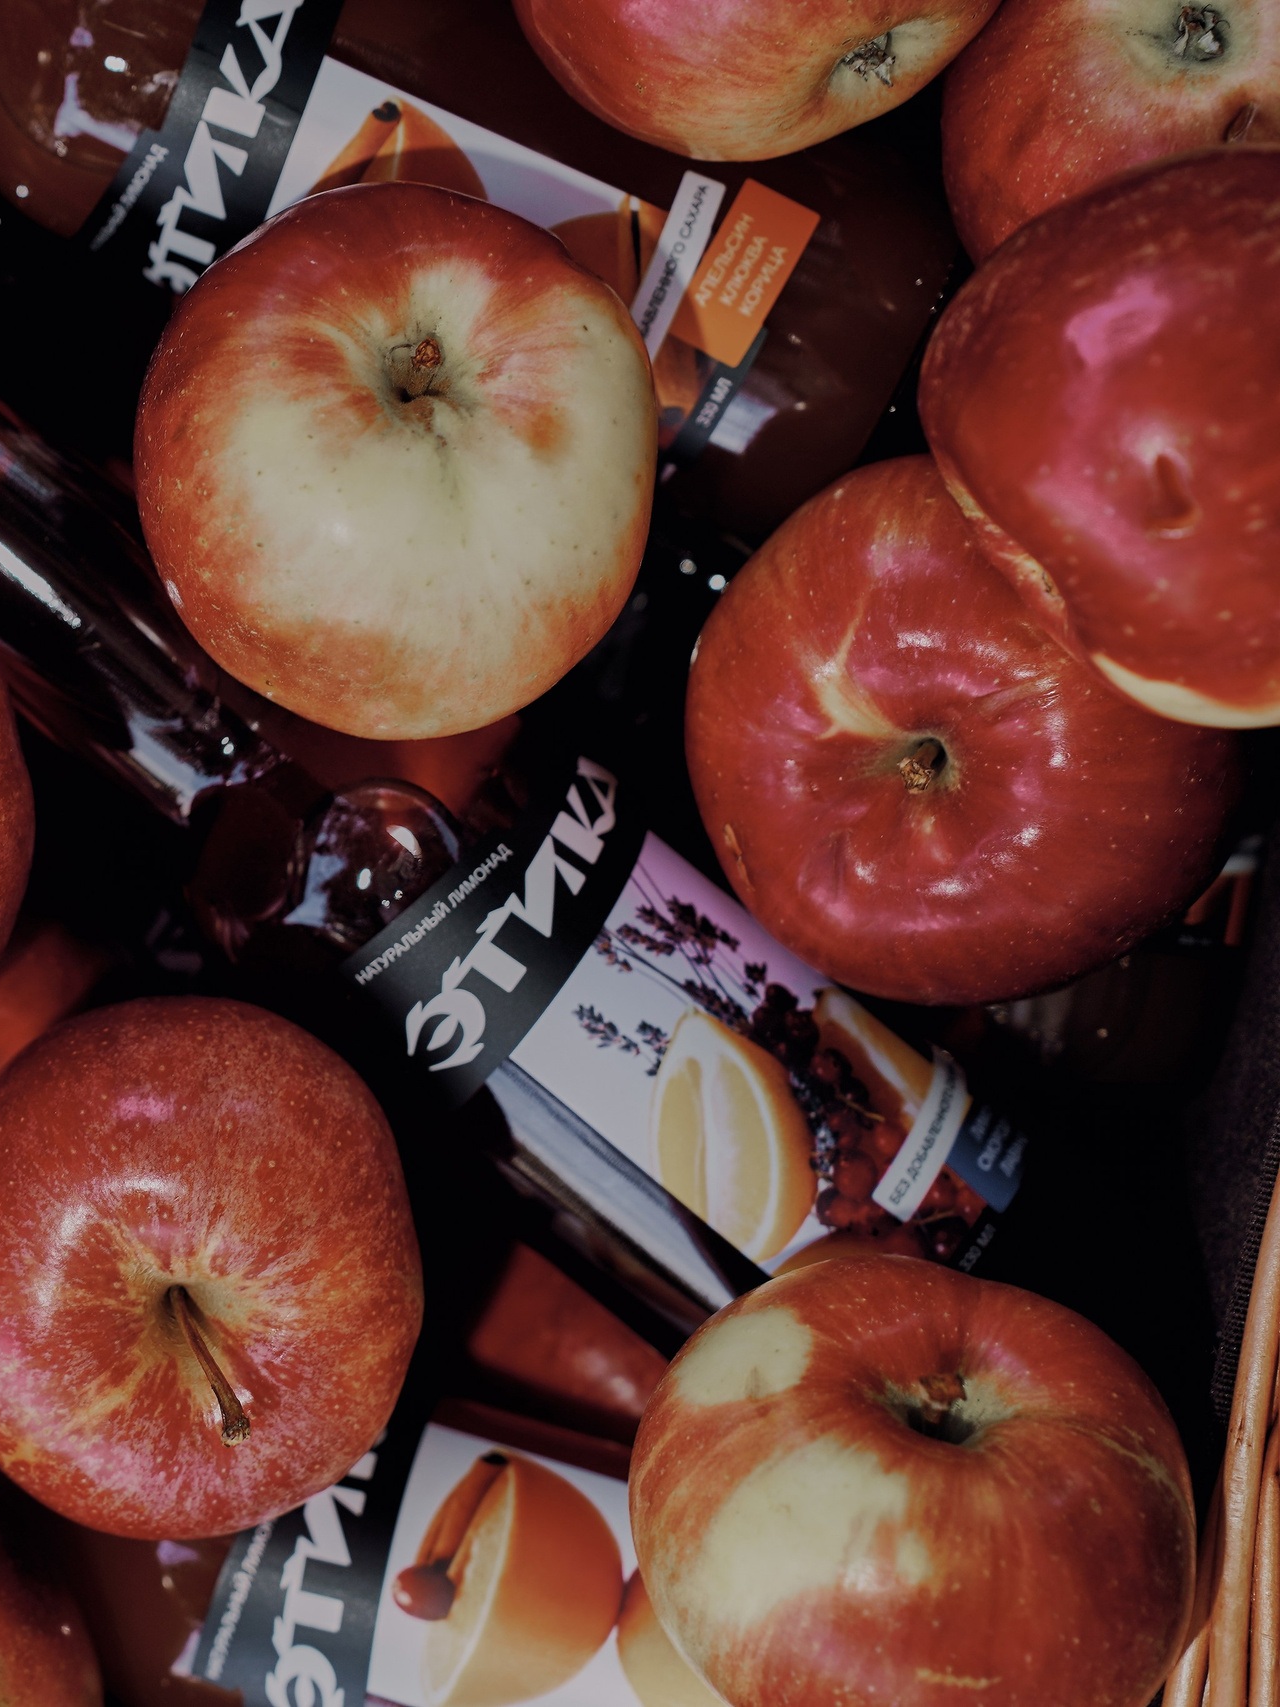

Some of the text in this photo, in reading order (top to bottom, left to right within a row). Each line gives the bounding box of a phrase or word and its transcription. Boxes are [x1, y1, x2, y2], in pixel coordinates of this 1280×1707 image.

[640, 184, 709, 337] АВЛЕННОГО САХАРА
[694, 212, 755, 308] АПЕЛЬСИН
[718, 235, 769, 307] КЛЮКВА
[738, 245, 788, 317] КОРИЦА
[354, 842, 514, 986] НАТУРАЛЬНЫЙ ЛИМОНАД
[405, 754, 619, 1073] ЭТИКА
[889, 1178, 911, 1205] БЕЗ
[265, 1428, 388, 1707] ЭТИ
